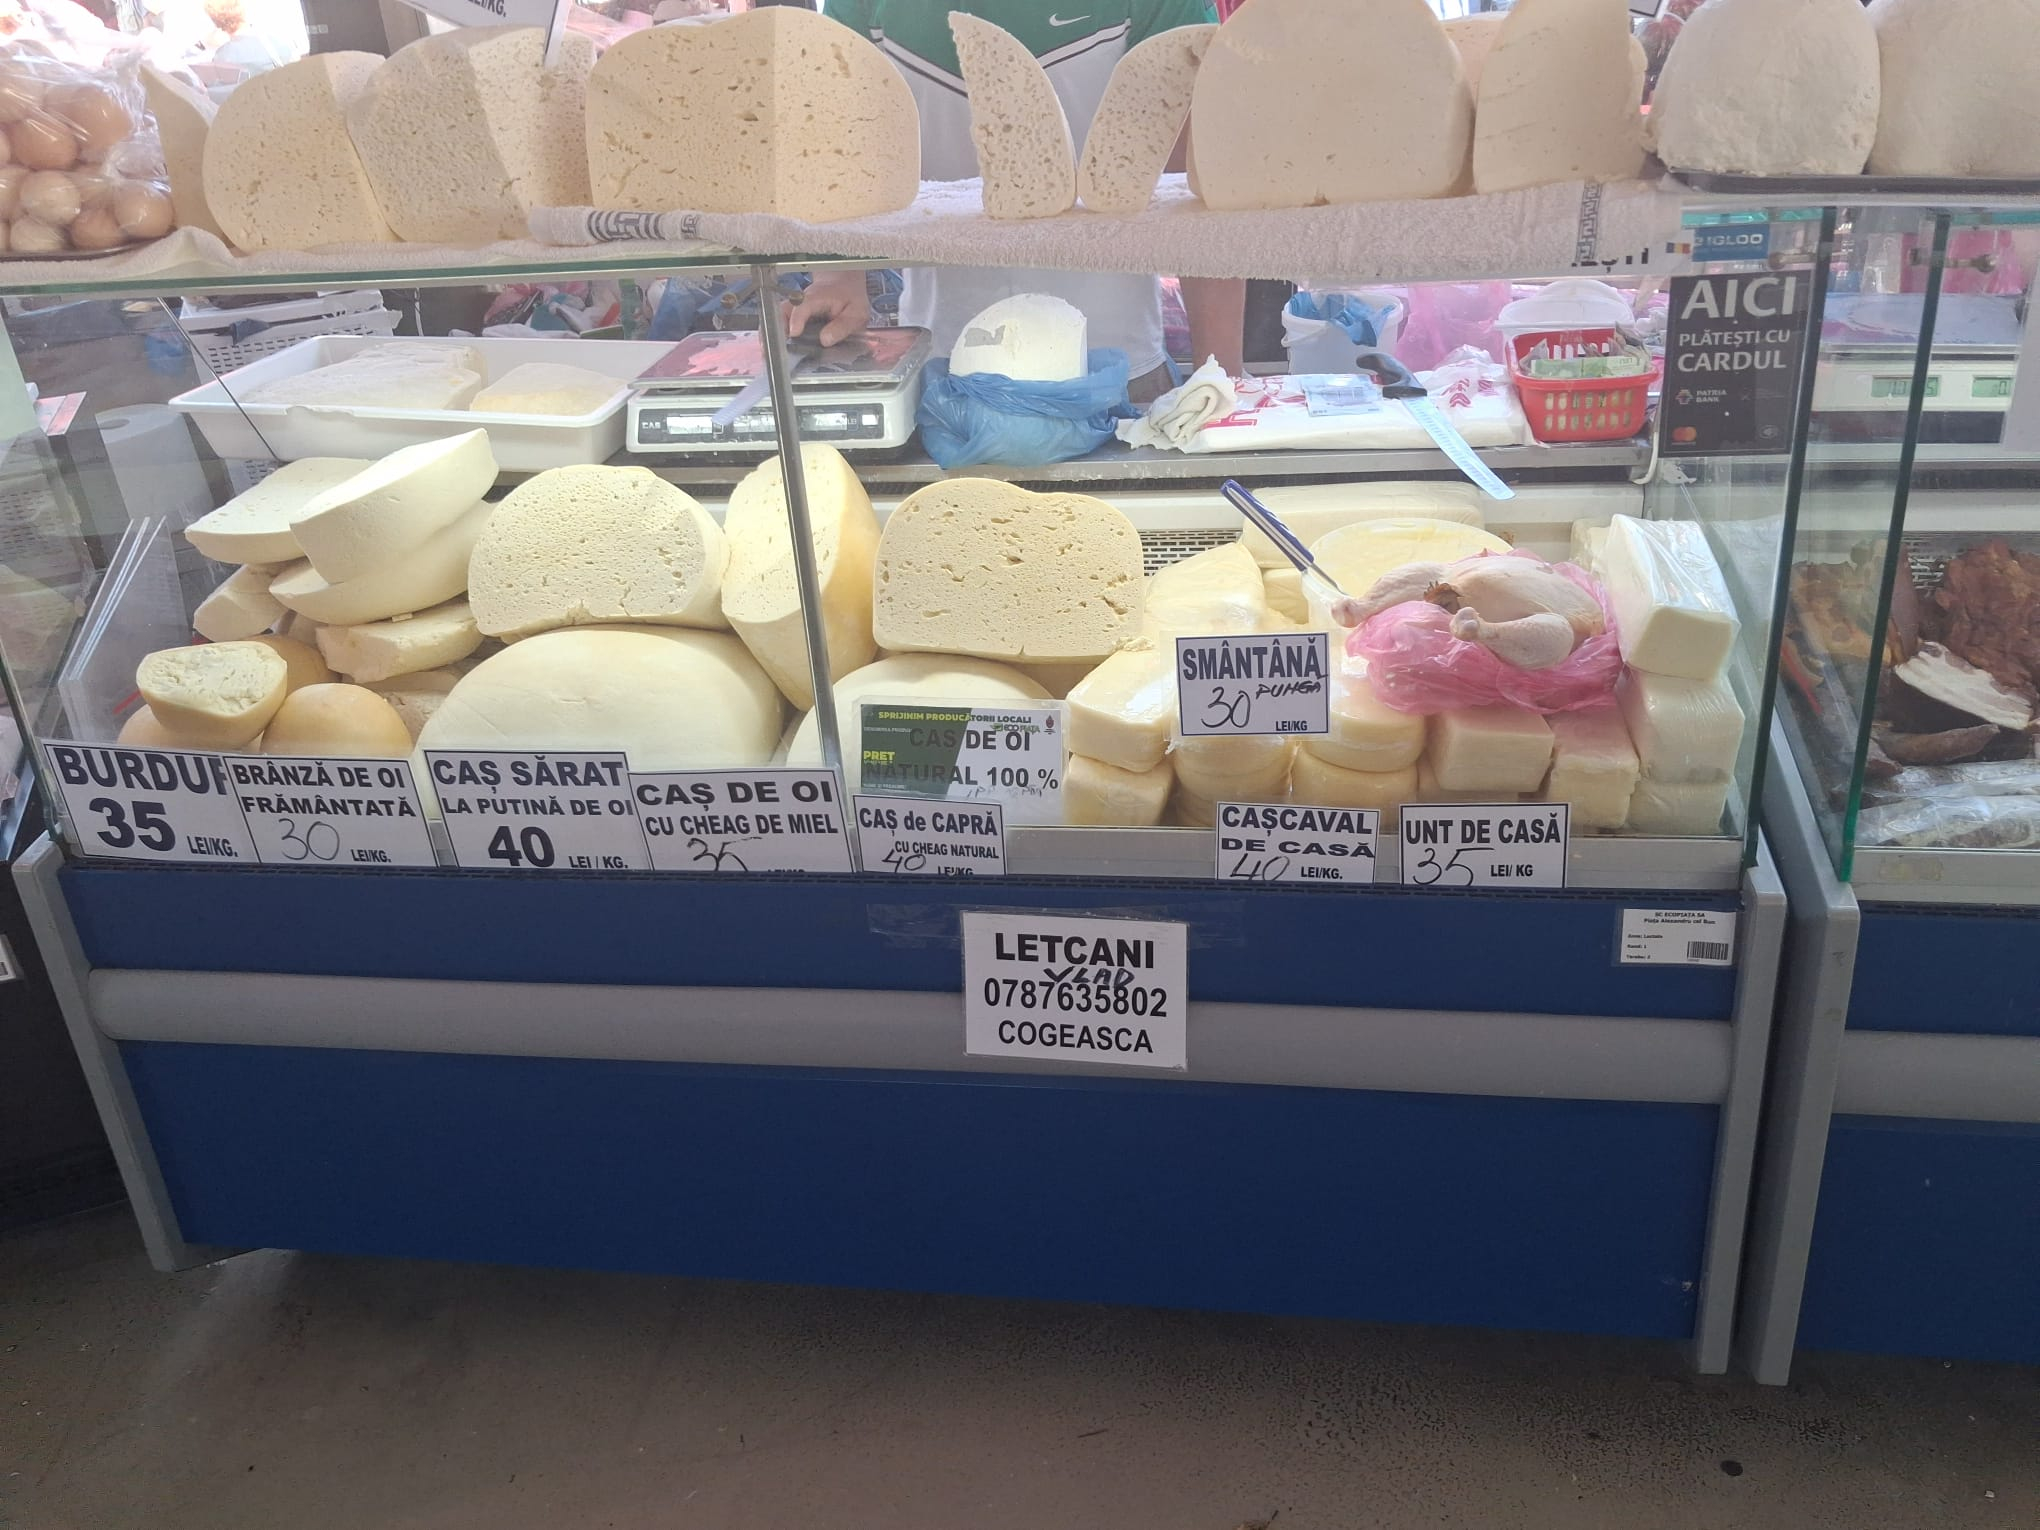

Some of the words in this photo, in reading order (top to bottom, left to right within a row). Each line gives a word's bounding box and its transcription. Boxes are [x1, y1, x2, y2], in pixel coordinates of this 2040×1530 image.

[1707, 233, 1763, 247] IGLOO
[1680, 276, 1797, 320] AICI
[1679, 329, 1760, 348] PLĂTEȘTI
[1765, 329, 1791, 343] CU
[1677, 351, 1787, 373] CARDUL
[1182, 637, 1321, 680] SMÂNTÂNĂ
[878, 710, 924, 720] SPRIJINIM
[997, 715, 1032, 724] LOCALI
[1200, 686, 1251, 728] 30
[1275, 720, 1308, 732] LEI/KG
[965, 730, 997, 750] DE
[1005, 731, 1031, 752] OI
[233, 762, 335, 788] BRÂNZĂ
[342, 767, 372, 788] DE
[378, 767, 404, 788] OI
[433, 759, 501, 794] CAȘ
[510, 755, 623, 787] SĂRAT
[864, 763, 978, 786] NATURAL
[987, 766, 1029, 788] 100
[1037, 769, 1059, 790] %
[240, 795, 416, 817] FRĂMÂNTATĂ
[442, 797, 472, 814] LA
[477, 795, 565, 815] PUTINĂ
[570, 799, 601, 815] DE
[608, 799, 633, 815] OI
[636, 783, 715, 811] CAȘ
[727, 781, 780, 803] DE
[792, 780, 833, 803] OI
[89, 797, 176, 852] 35
[646, 816, 674, 836] CU
[680, 814, 750, 835] CHEAG
[756, 814, 783, 834] DE
[789, 814, 838, 834] MIEL
[859, 807, 898, 837] CAȘ
[904, 811, 927, 832] de
[932, 811, 998, 836] CAPRĂ
[1222, 806, 1373, 837] CAȘCAVAL
[1405, 819, 1453, 845] UNT
[1461, 819, 1491, 844] DE
[1498, 812, 1561, 844] CASĂ
[187, 834, 239, 858] LEI/KG.
[277, 818, 340, 861] 30
[488, 825, 555, 868] 40
[895, 840, 909, 853] CU
[912, 842, 948, 856] CHEAG
[951, 844, 999, 859] NATURAL
[1221, 838, 1266, 852] DE
[1278, 840, 1376, 858] CASĂ
[351, 848, 391, 863] LEI/KG.
[881, 849, 927, 874] 40
[1230, 853, 1290, 881] 40
[1412, 847, 1496, 886] 35
[1300, 866, 1343, 880] LEI/KG.
[995, 932, 1154, 968] LETCANI
[984, 977, 1167, 1018] 0787635802
[998, 1019, 1154, 1053] COGEASCA
